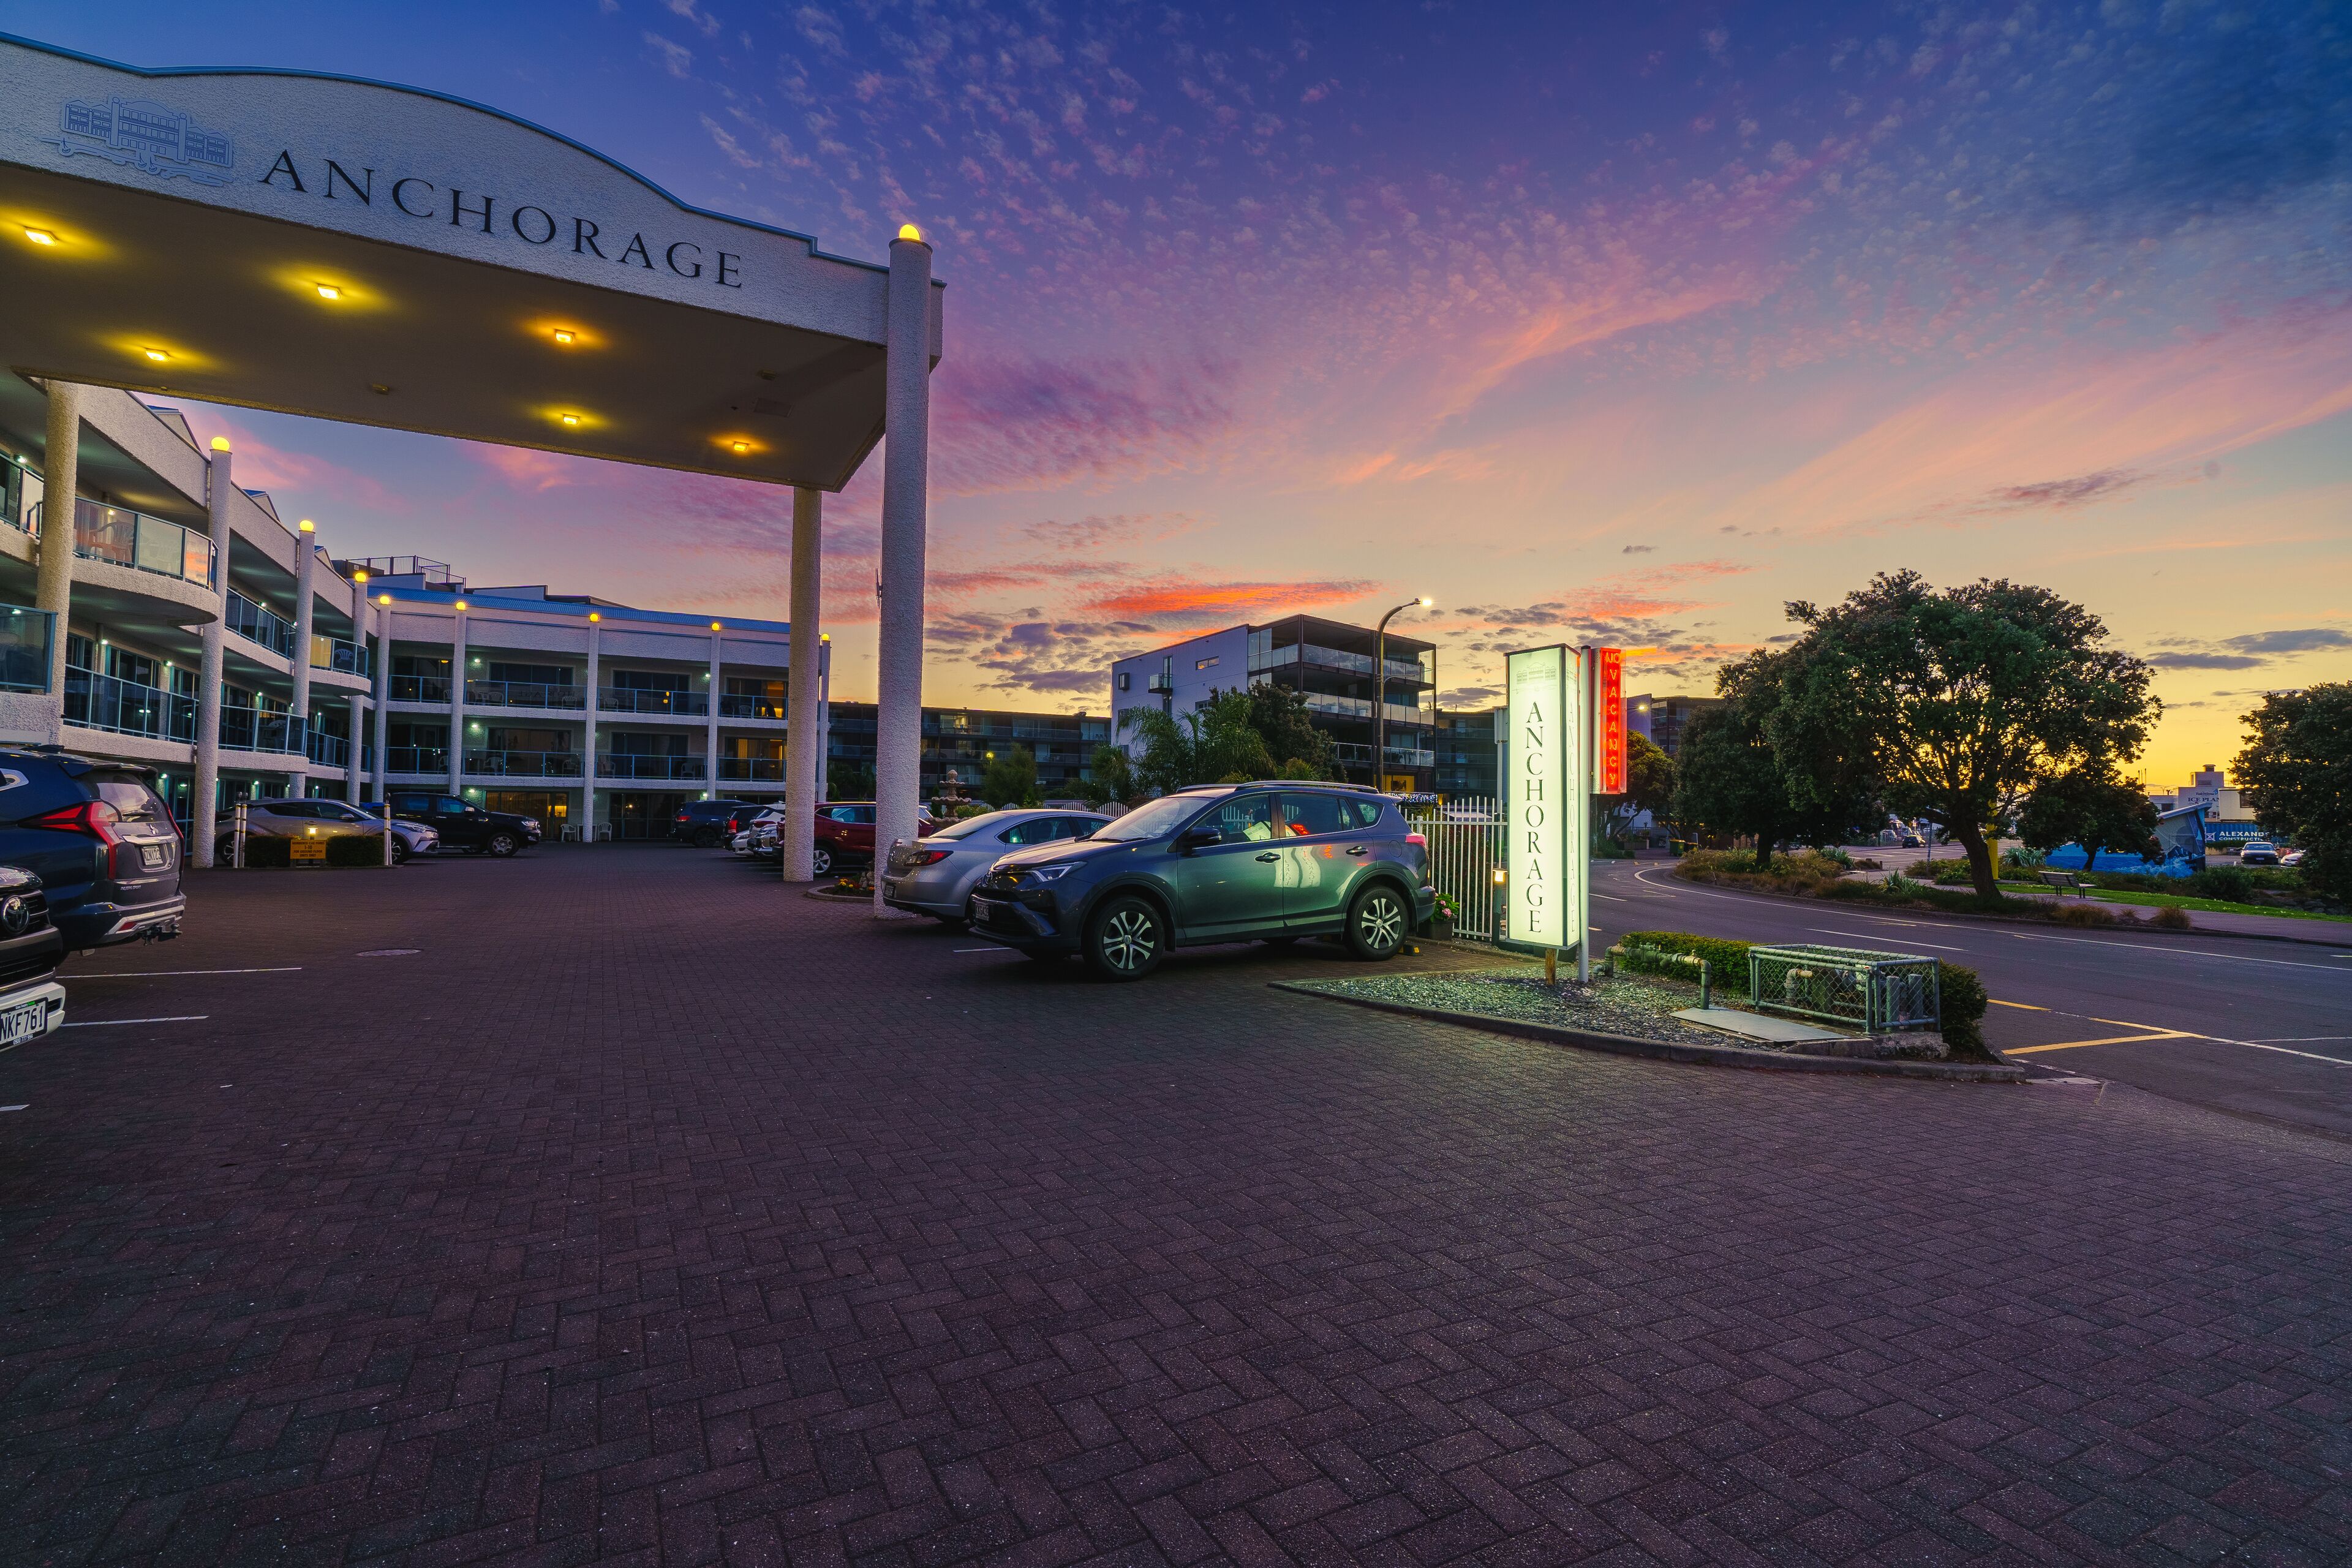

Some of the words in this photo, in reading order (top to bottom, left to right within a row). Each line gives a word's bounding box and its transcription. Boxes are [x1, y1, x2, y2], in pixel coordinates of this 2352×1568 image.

[257, 149, 742, 288] ANCHORAGE
[1605, 652, 1621, 663] NO
[1608, 669, 1618, 785] VACANCY
[1525, 701, 1544, 933] ANCHORAGE
[0, 1006, 43, 1041] NKF761
